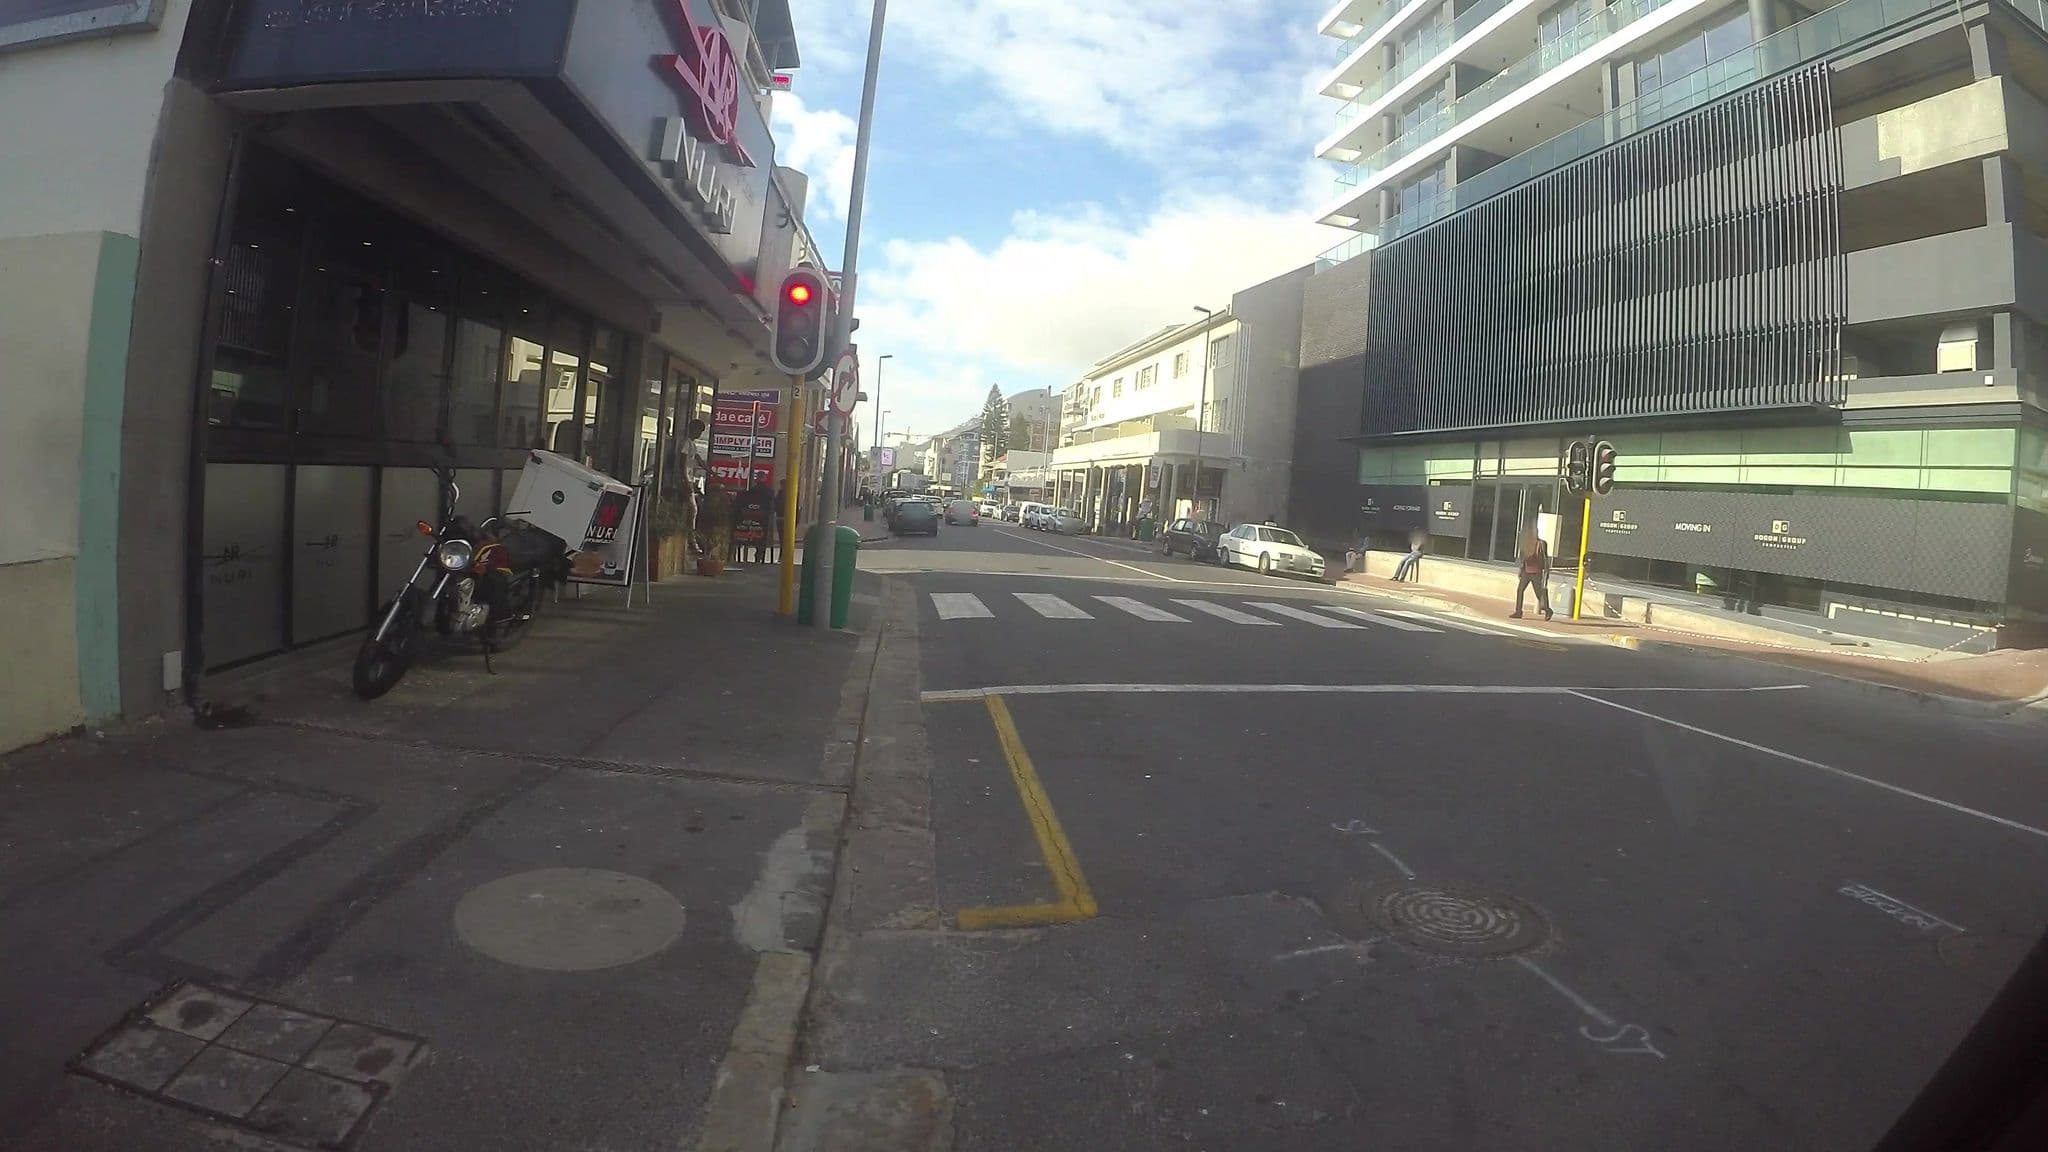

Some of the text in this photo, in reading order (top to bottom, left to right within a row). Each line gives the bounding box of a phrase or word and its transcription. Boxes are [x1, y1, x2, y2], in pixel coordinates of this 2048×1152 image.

[711, 466, 770, 480] STN
[586, 524, 618, 538] NURI
[1674, 522, 1711, 533] MOVING IN
